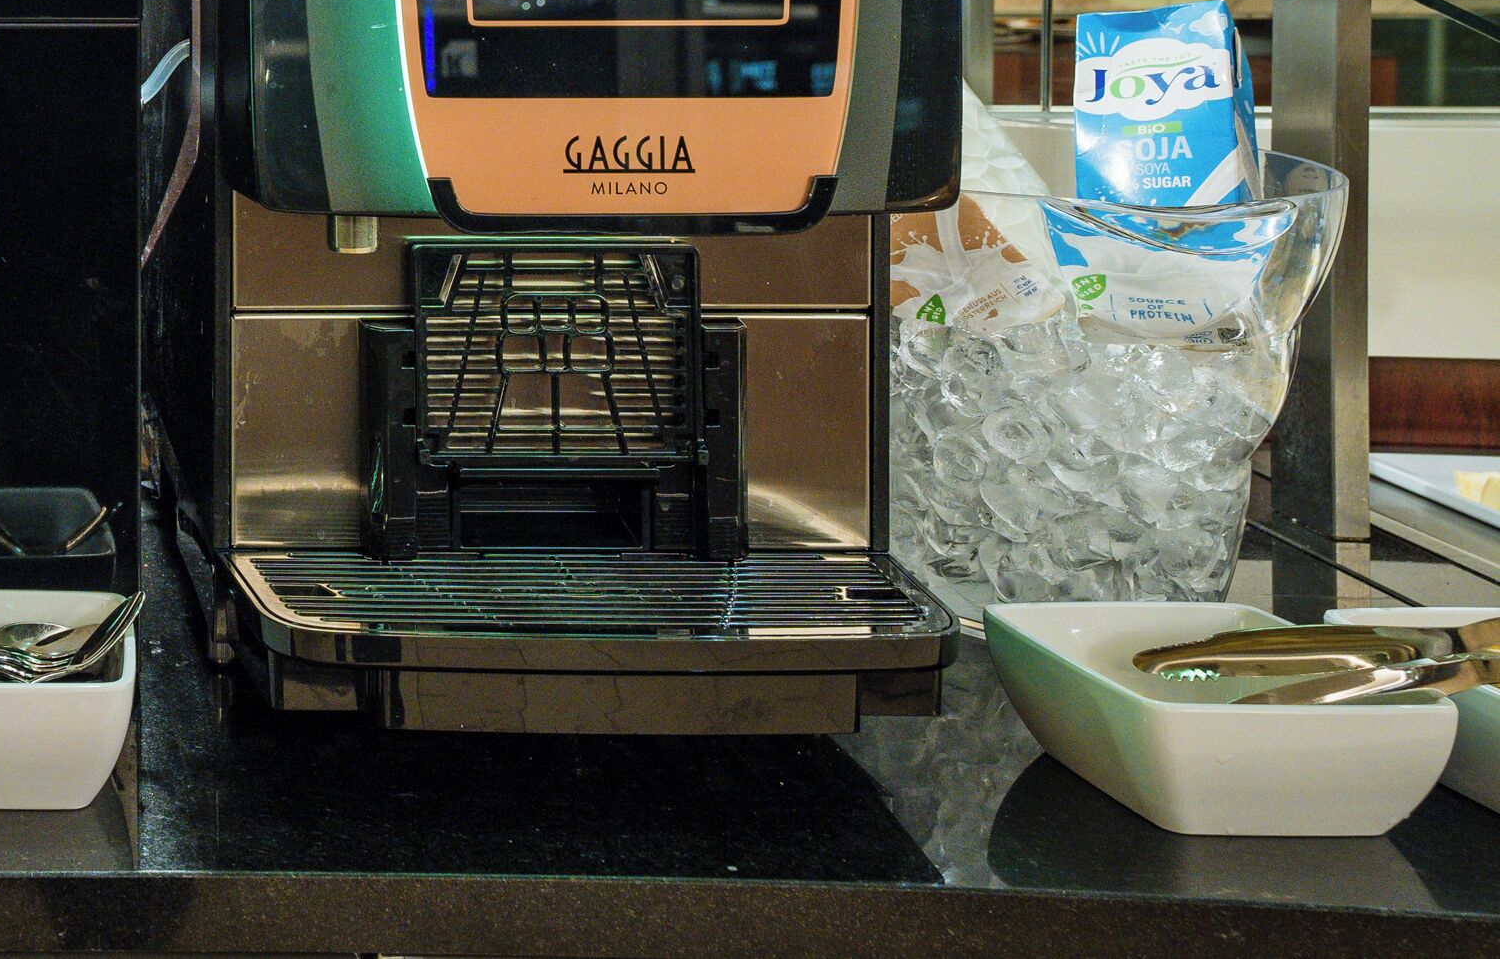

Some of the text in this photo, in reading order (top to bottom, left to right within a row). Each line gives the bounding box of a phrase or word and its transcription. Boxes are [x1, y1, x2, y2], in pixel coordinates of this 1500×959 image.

[1085, 65, 1221, 105] Joya
[564, 135, 693, 172] GAGGIA
[1135, 161, 1171, 176] SOYA
[591, 181, 668, 195] MILANO
[1142, 175, 1192, 189] SUGAR
[1128, 297, 1186, 305] SOURCE
[1129, 309, 1195, 325] PROTEIN
